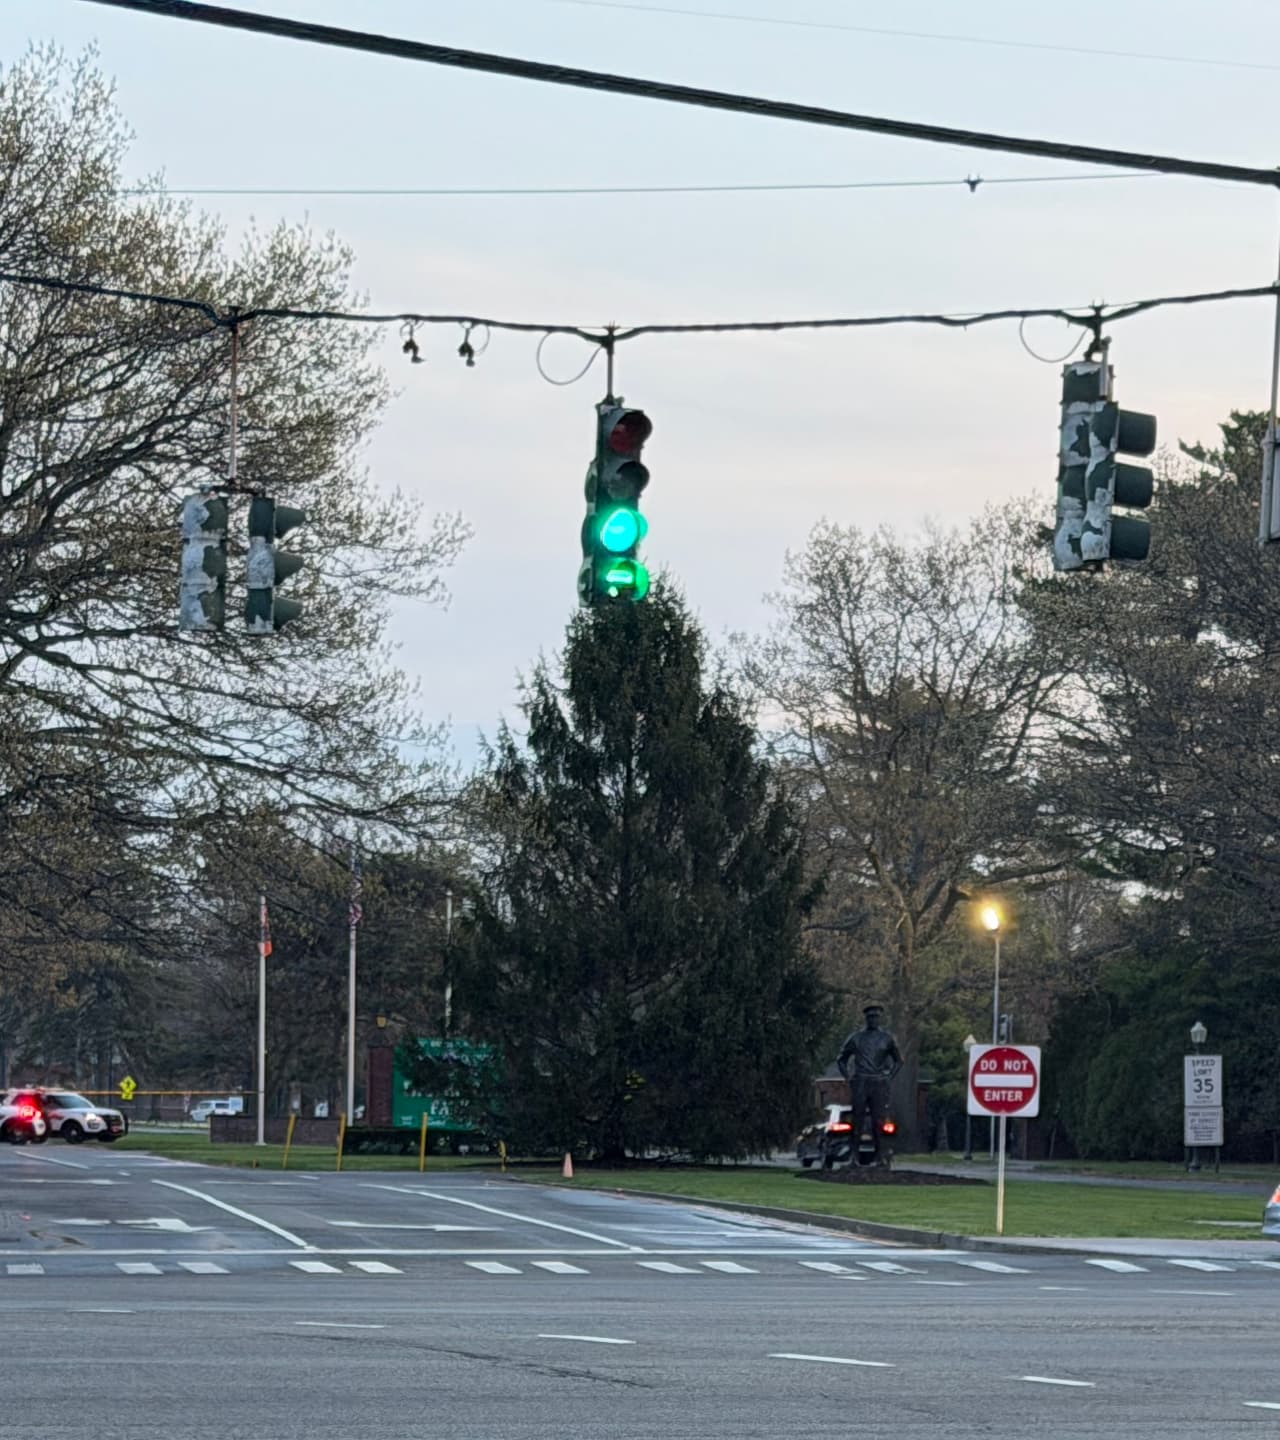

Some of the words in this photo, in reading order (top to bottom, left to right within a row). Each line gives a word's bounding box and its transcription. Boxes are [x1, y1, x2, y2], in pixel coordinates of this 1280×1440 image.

[980, 1059, 998, 1071] DO
[1004, 1059, 1028, 1071] NOT
[1193, 1078, 1214, 1093] 35
[984, 1090, 1023, 1102] ENTER
